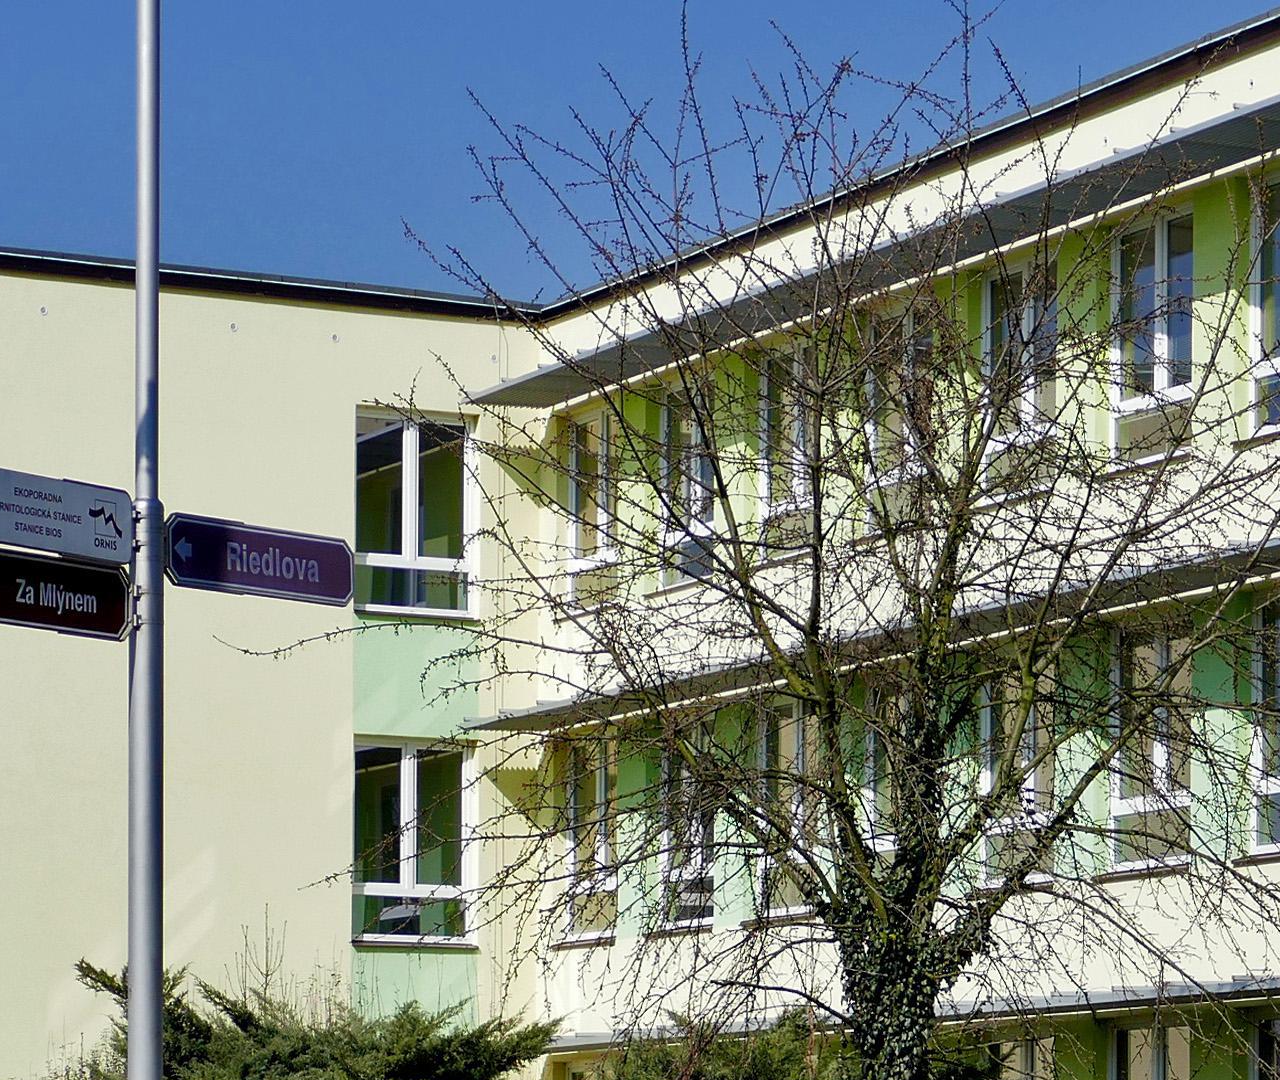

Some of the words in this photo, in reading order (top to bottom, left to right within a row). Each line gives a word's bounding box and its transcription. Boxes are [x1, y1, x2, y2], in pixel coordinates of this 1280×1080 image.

[14, 487, 63, 503] EKOPORADNA
[53, 512, 82, 524] STANICE
[14, 522, 44, 535] STANICE
[45, 527, 62, 538] BIOS
[94, 538, 117, 551] ORNIS
[226, 541, 319, 582] Riedlova
[15, 578, 34, 604] Za
[39, 581, 97, 615] Mlýnem
